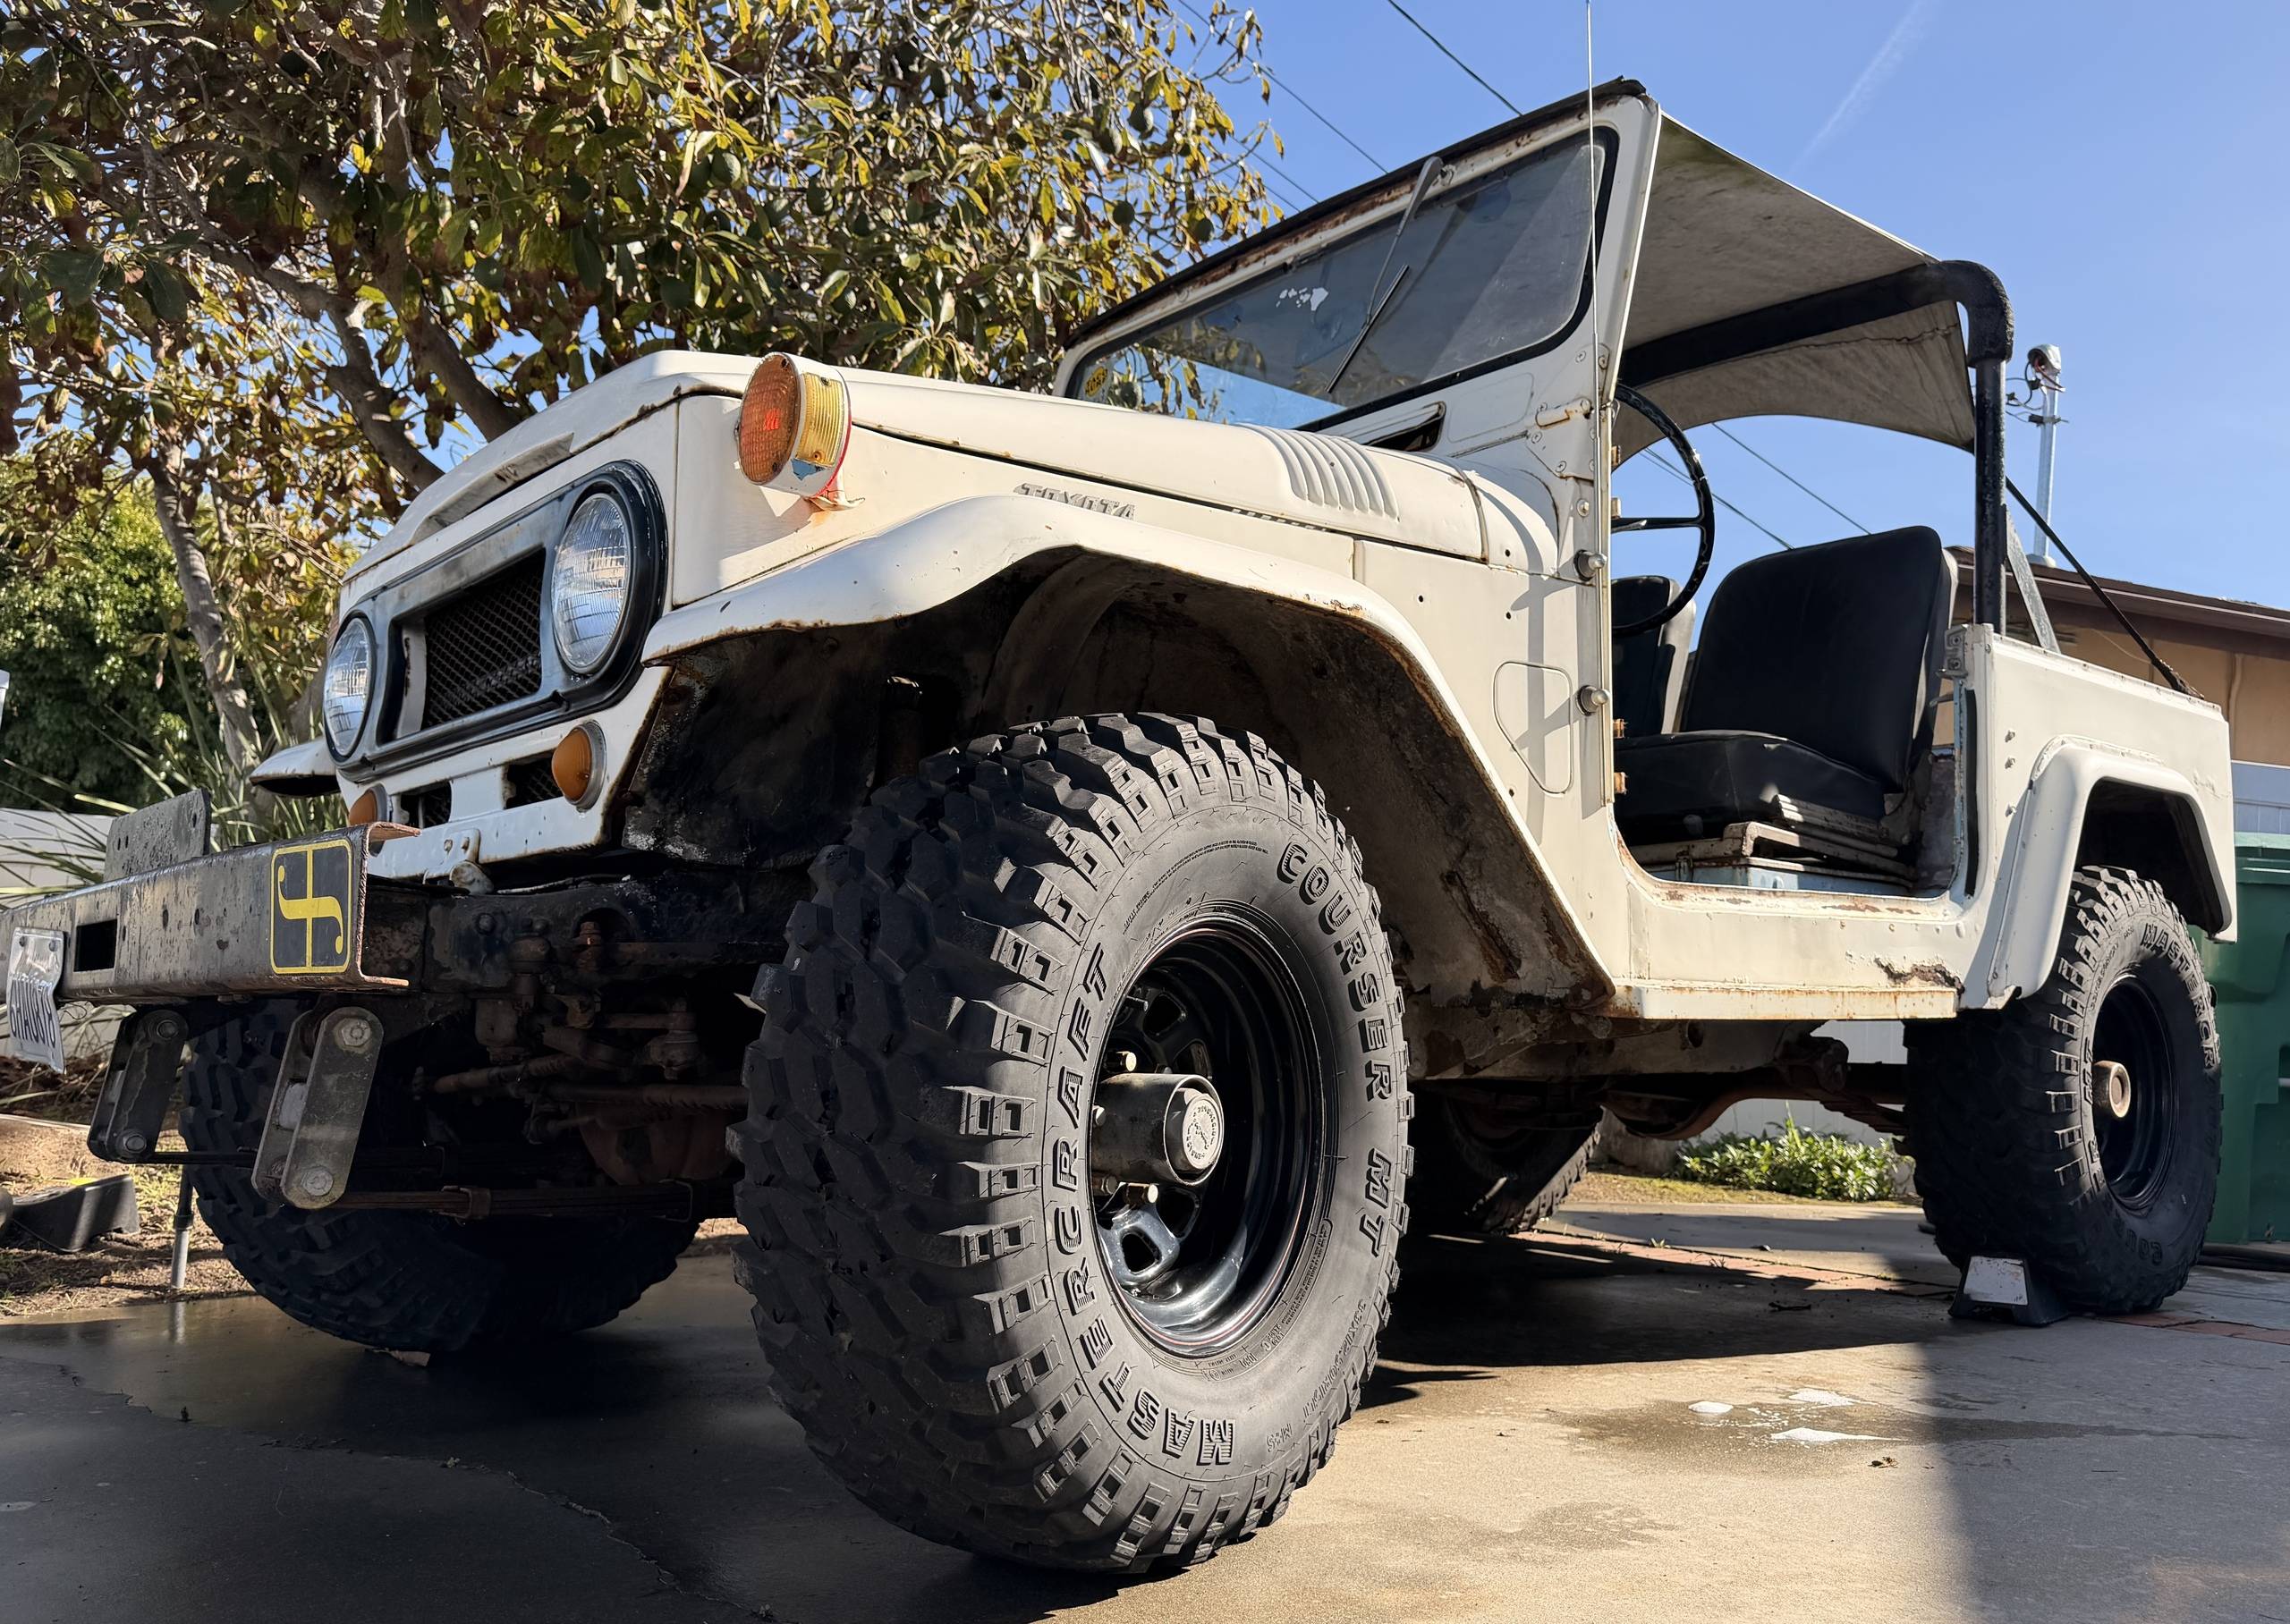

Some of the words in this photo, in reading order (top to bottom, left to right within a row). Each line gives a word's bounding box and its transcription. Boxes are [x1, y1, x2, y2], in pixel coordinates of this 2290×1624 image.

[1013, 483, 1136, 520] TOYOTA
[1053, 942, 1235, 1466] MASTERCRAFT
[1276, 842, 1392, 1101] COURSER
[1357, 1147, 1393, 1257] MT
